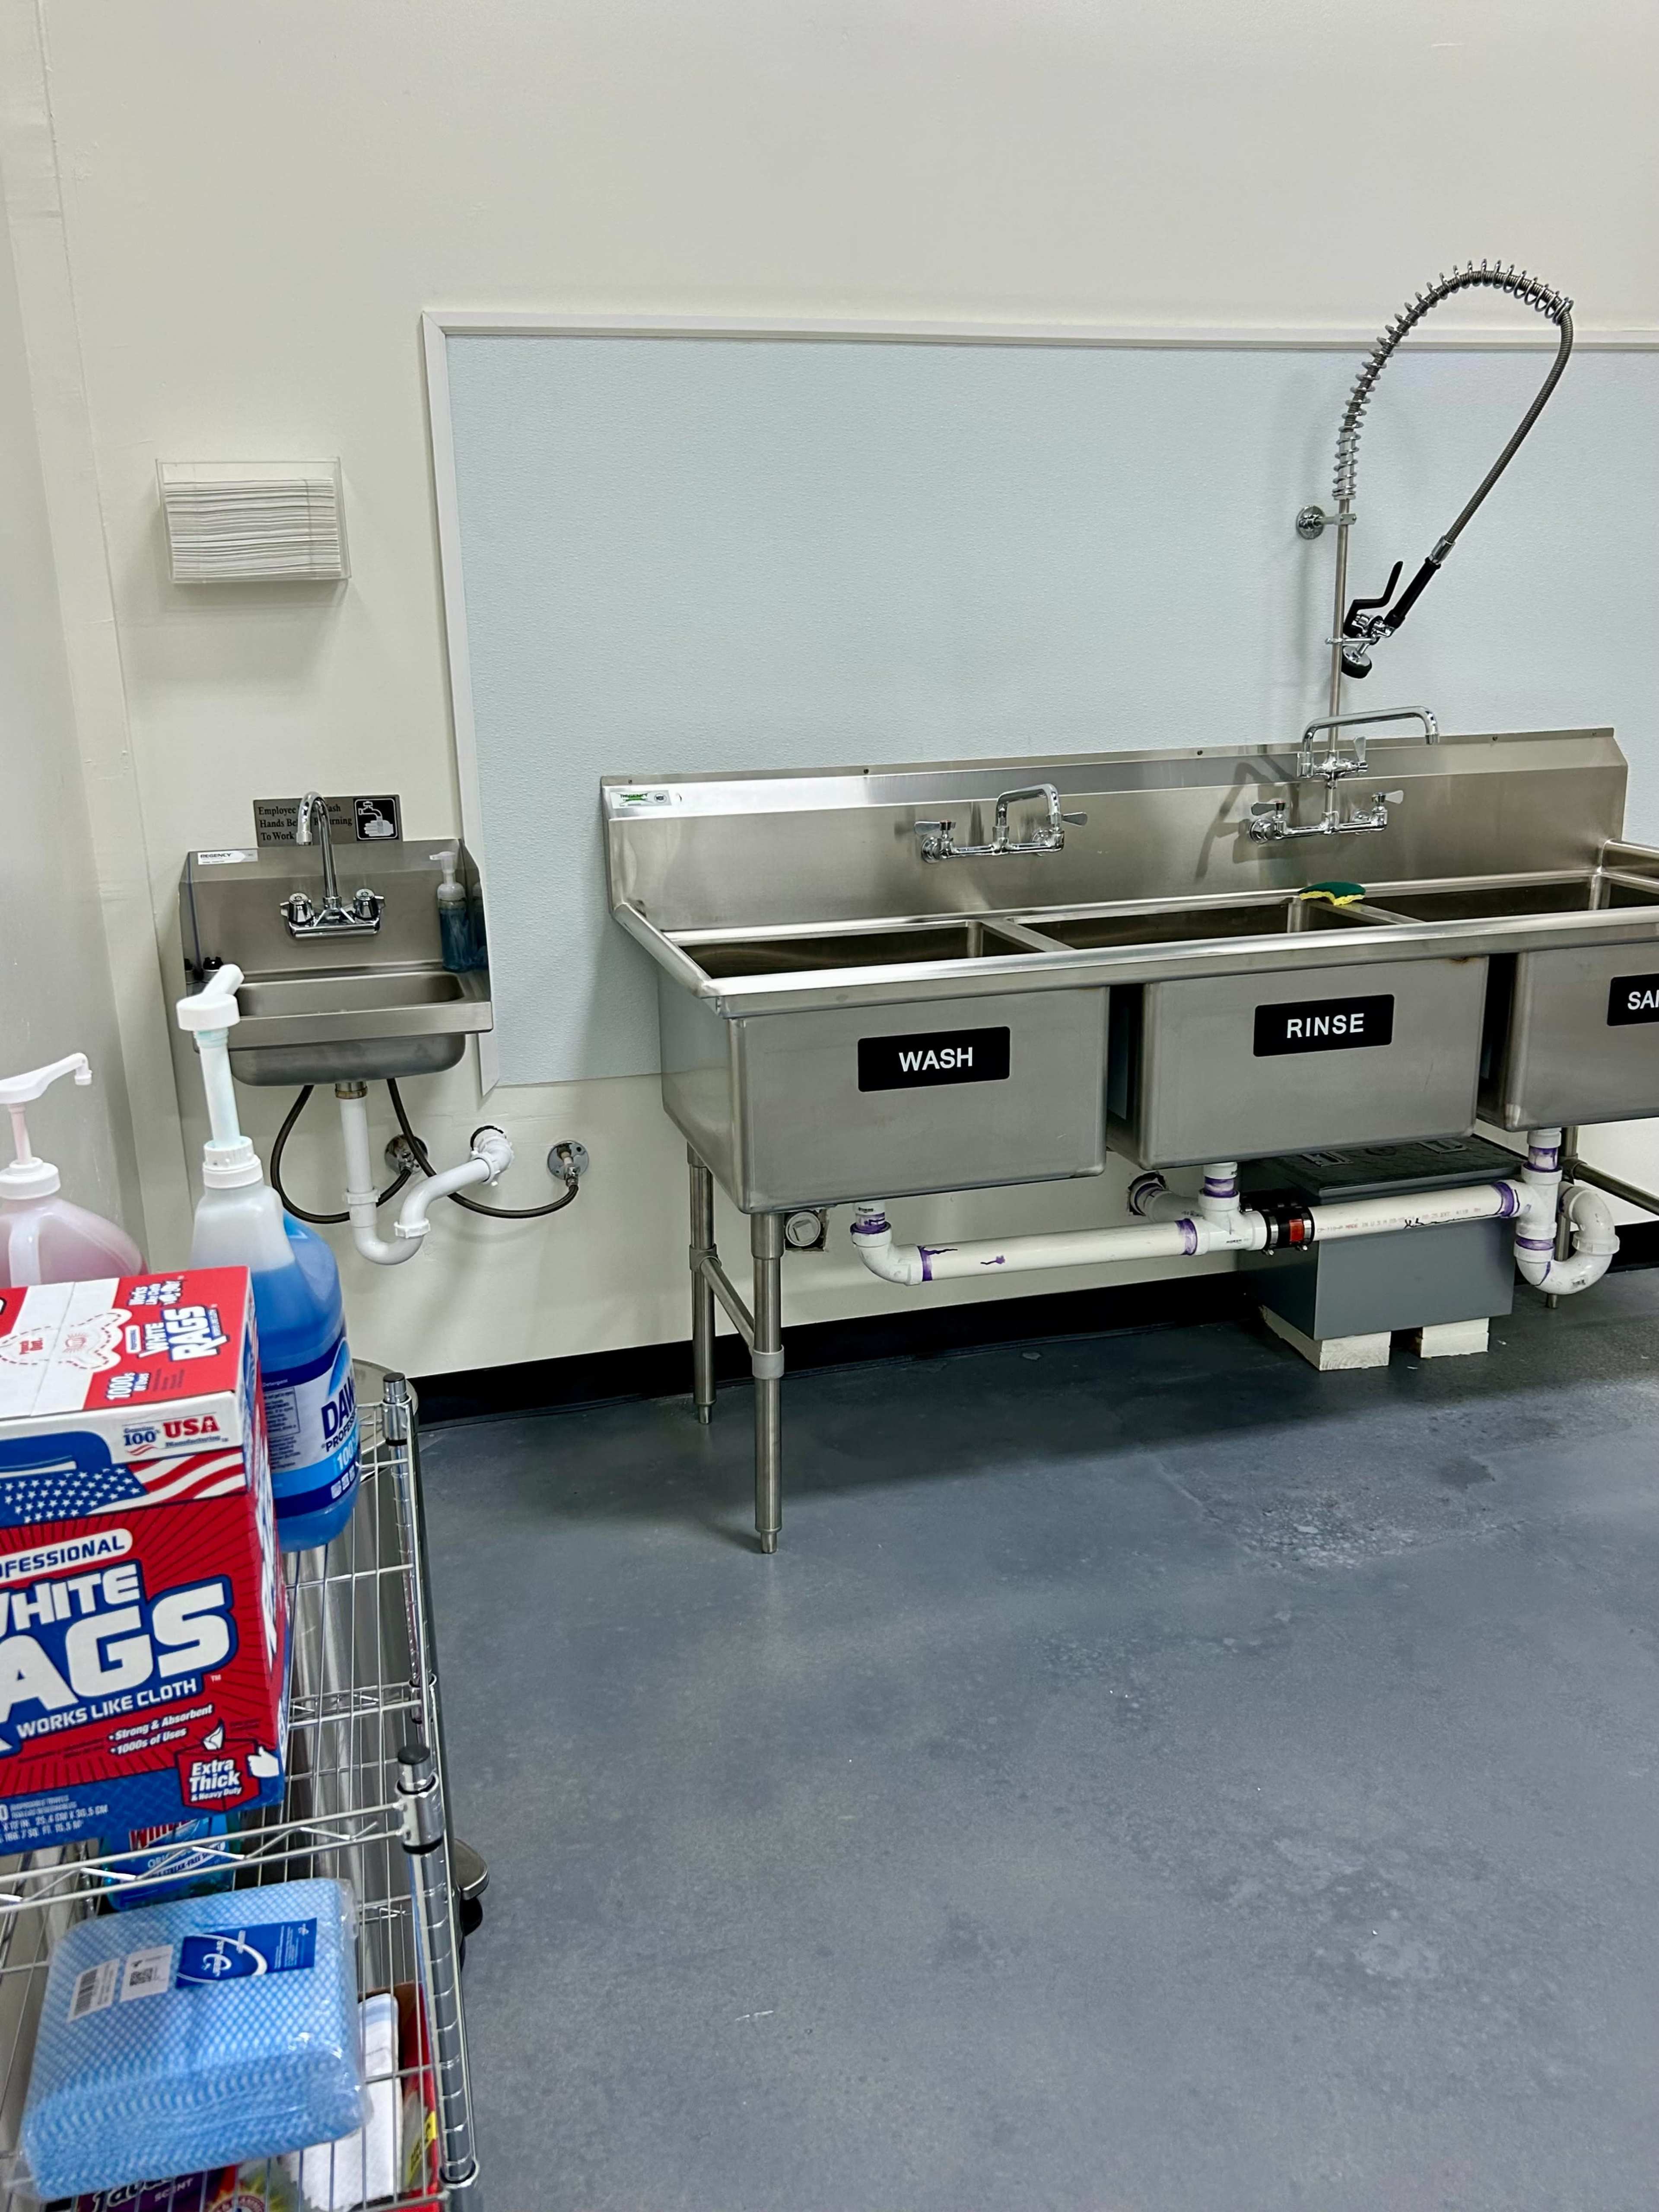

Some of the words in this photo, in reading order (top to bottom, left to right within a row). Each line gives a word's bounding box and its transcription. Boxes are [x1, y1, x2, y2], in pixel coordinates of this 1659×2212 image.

[258, 805, 296, 816] Employee
[327, 804, 341, 812] ash
[260, 819, 284, 828] Hands
[261, 832, 272, 841] To
[273, 831, 294, 840] Work
[1627, 989, 1659, 1010] SA
[1287, 1013, 1364, 1039] RINSE
[899, 1047, 973, 1072] WASH
[139, 1322, 169, 1358] WHITE
[163, 1306, 227, 1361] RAGS
[106, 1372, 136, 1400] 1000s
[163, 1415, 219, 1438] USA
[165, 1435, 221, 1447] Manufacturing
[0, 1536, 124, 1578] FESSIONAL
[0, 1583, 229, 1751] AGS
[16, 1707, 87, 1739] WORKS
[91, 1695, 133, 1719] LIKE
[137, 1678, 197, 1706] CLOTH
[115, 1722, 149, 1741] Strong
[151, 1720, 159, 1730] &
[162, 1704, 213, 1727] Absorbent
[117, 1739, 148, 1755] 1000s
[149, 1734, 161, 1746] of
[163, 1729, 187, 1743] Uses
[192, 1759, 235, 1776] Extra
[189, 1770, 241, 1793] Thick
